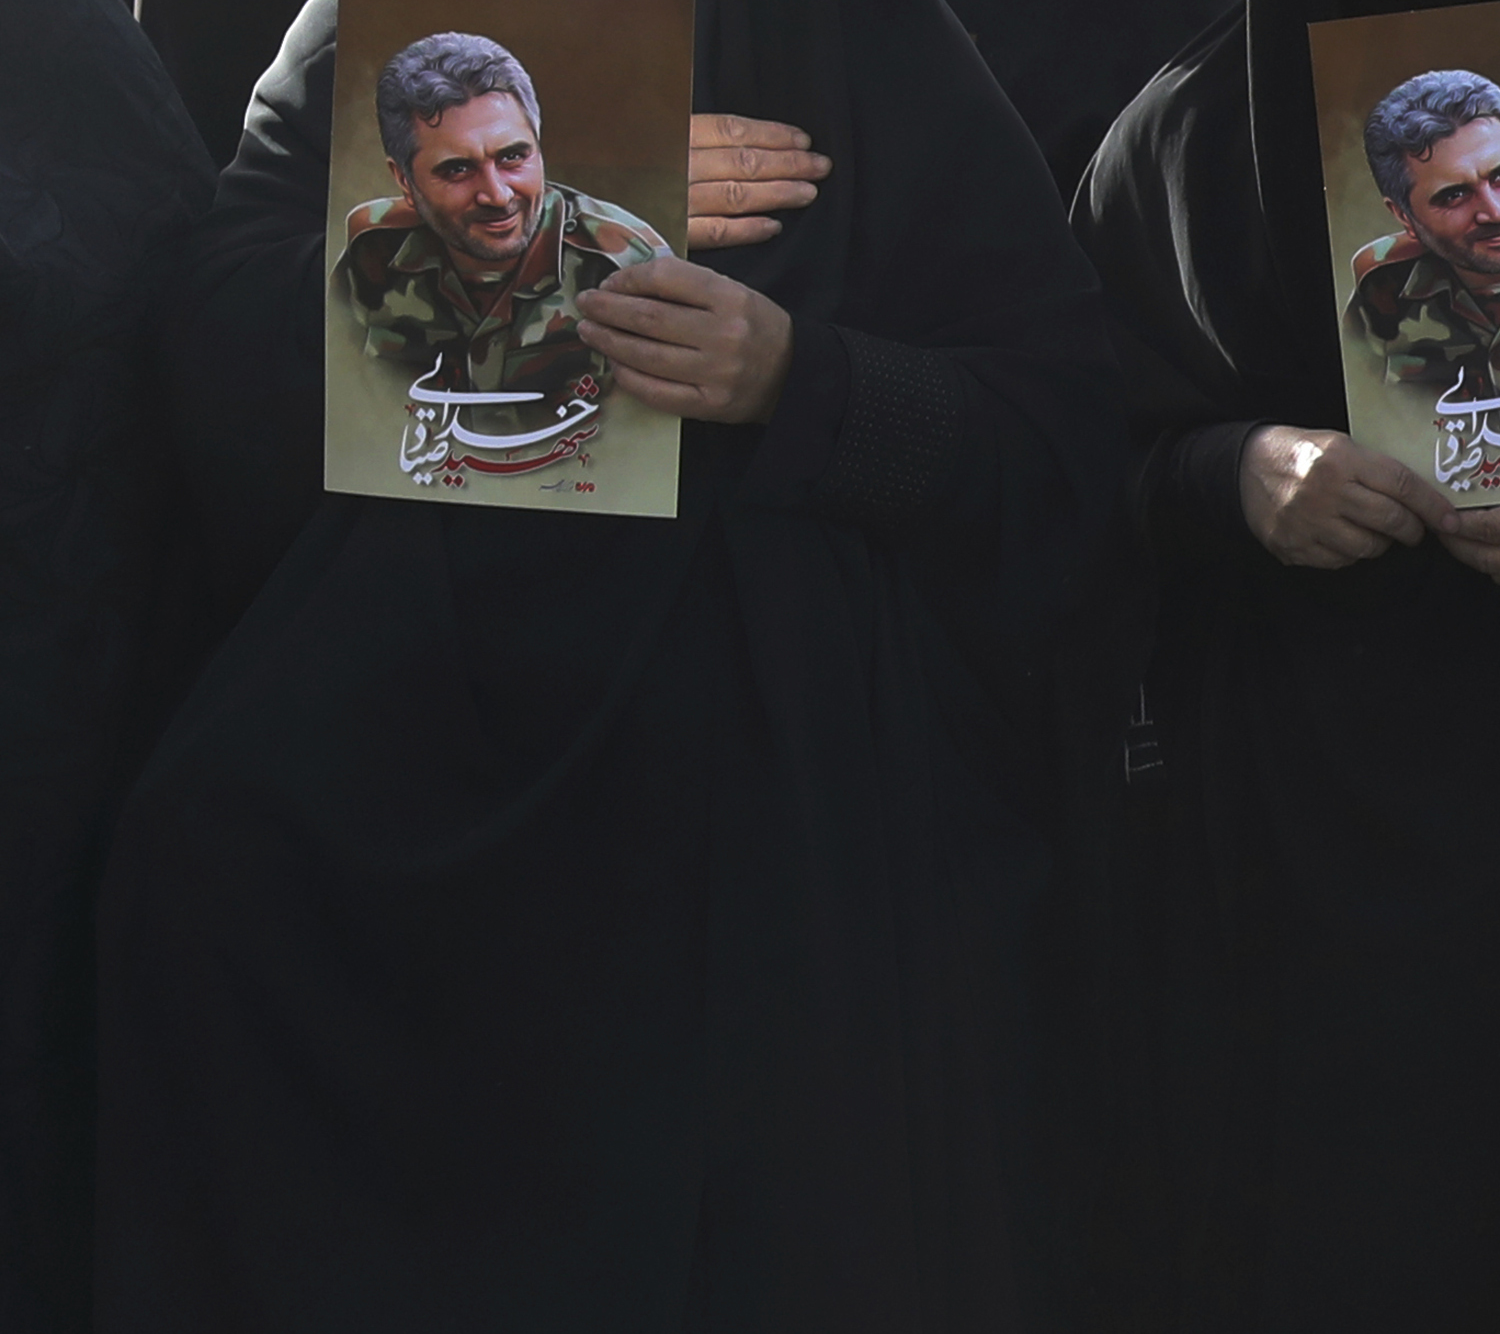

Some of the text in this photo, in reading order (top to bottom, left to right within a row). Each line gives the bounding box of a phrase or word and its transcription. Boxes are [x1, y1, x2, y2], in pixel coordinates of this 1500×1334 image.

[399, 422, 449, 485] صیاد
[430, 374, 599, 488] شهید
[1435, 432, 1482, 492] صیاد
